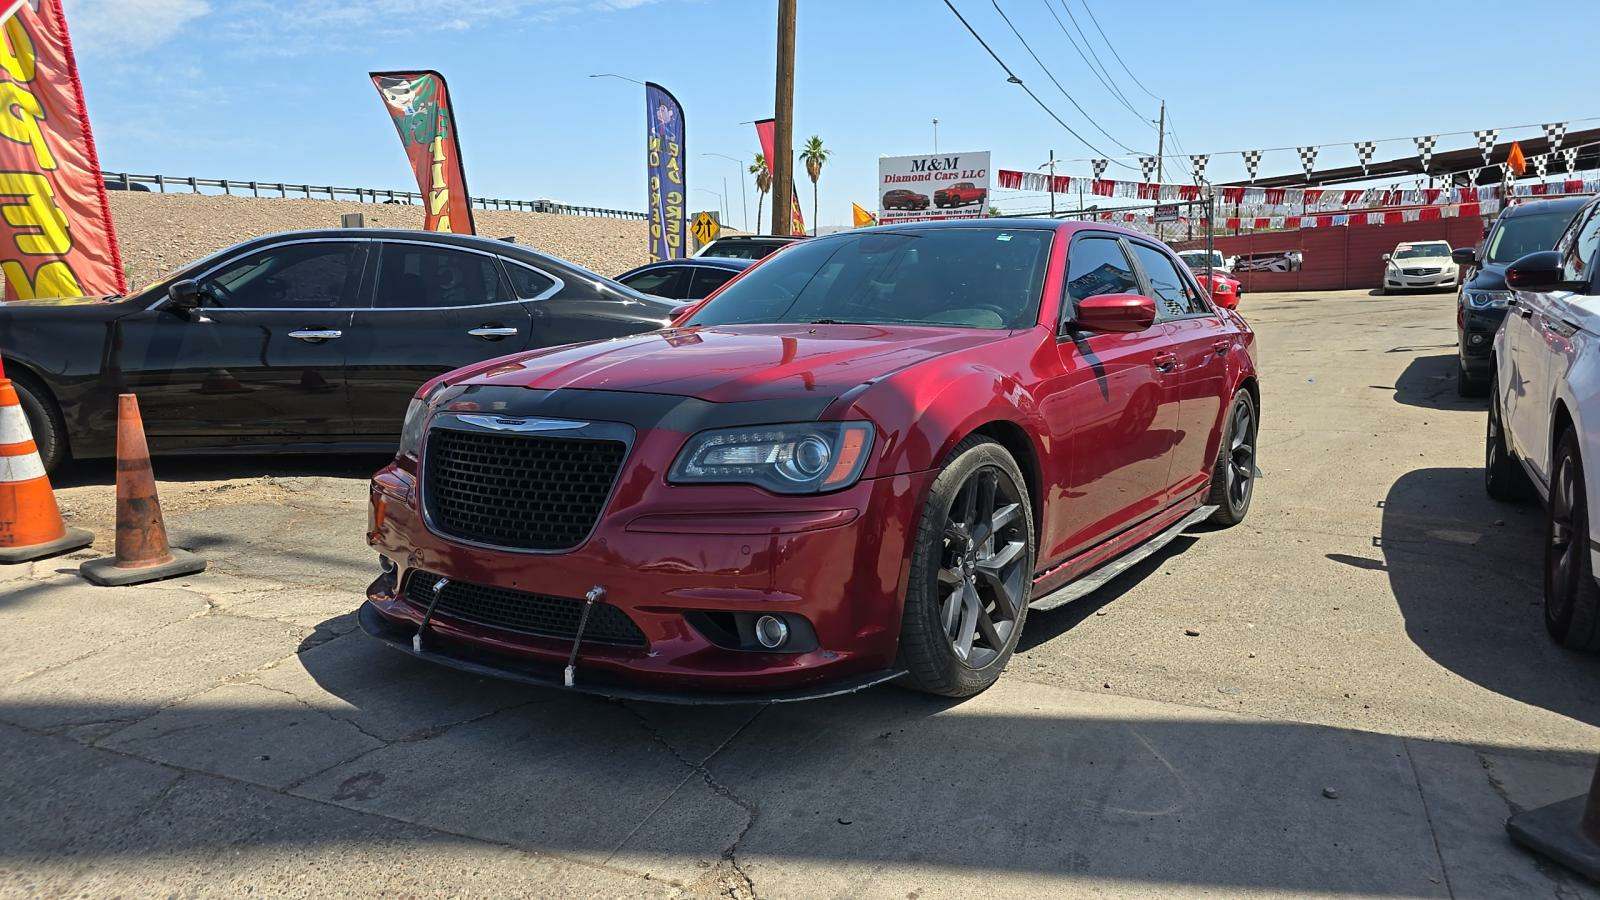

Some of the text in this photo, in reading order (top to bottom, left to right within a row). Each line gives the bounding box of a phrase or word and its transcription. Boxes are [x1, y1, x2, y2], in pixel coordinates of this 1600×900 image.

[911, 157, 959, 172] M&M
[884, 169, 986, 183] Diamond Cars LLC
